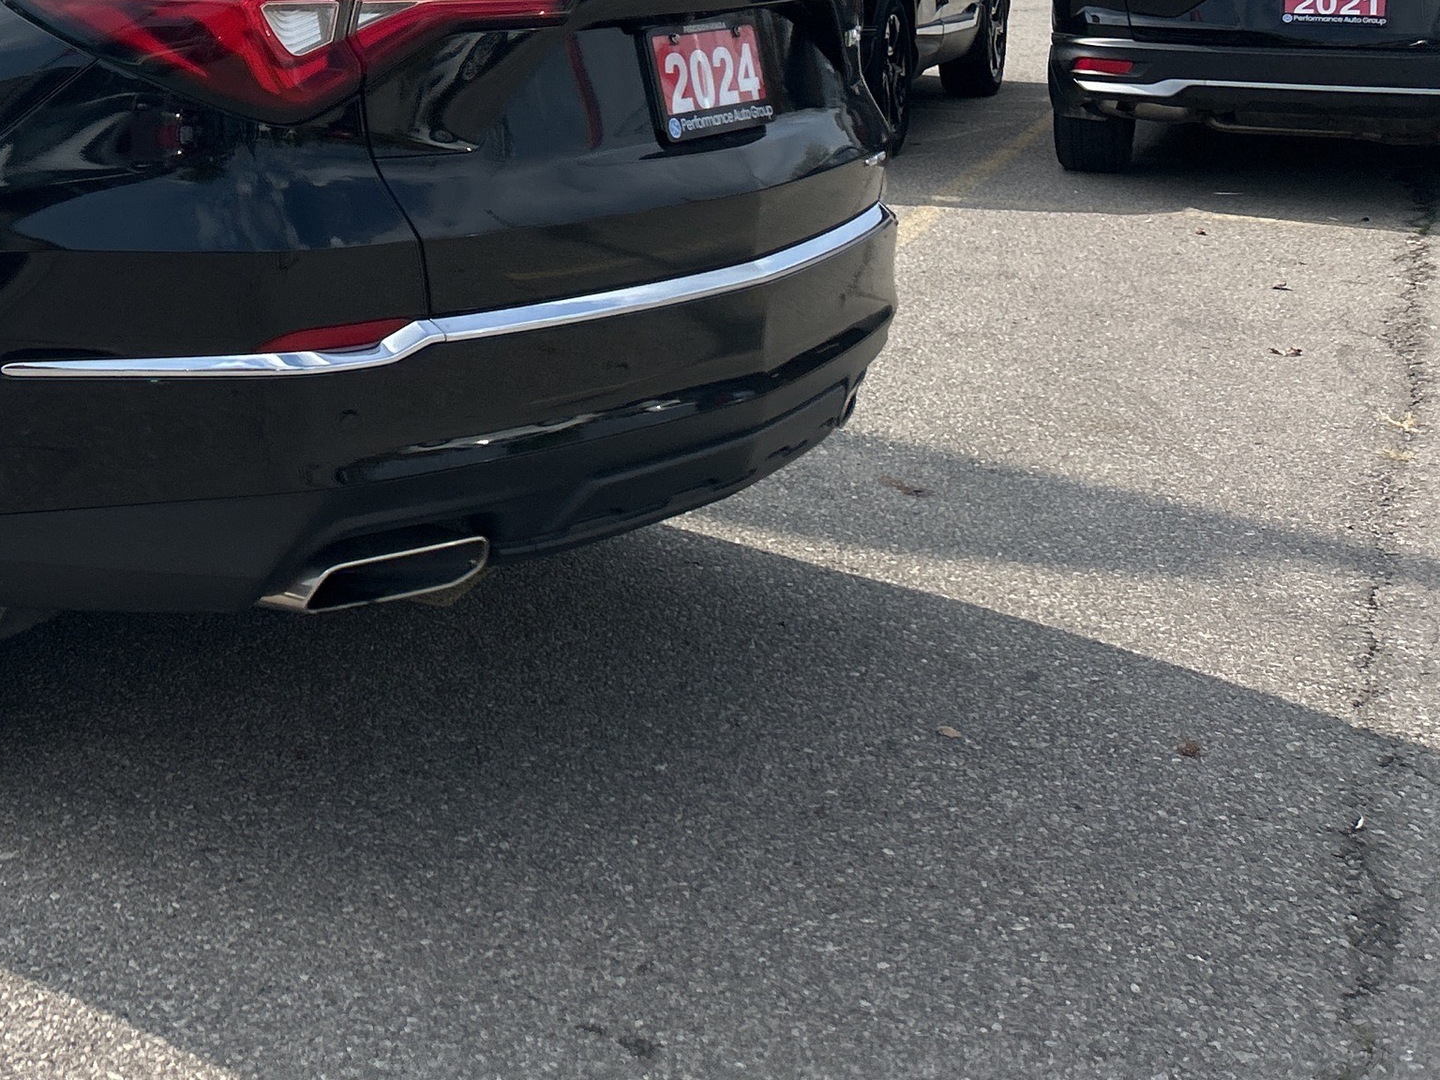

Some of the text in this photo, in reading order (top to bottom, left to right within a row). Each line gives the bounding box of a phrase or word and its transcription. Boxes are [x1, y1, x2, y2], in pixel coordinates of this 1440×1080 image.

[1293, 15, 1387, 26] Performance Auto Group
[664, 43, 761, 115] 2024
[681, 104, 774, 131] Performance Auto Group
